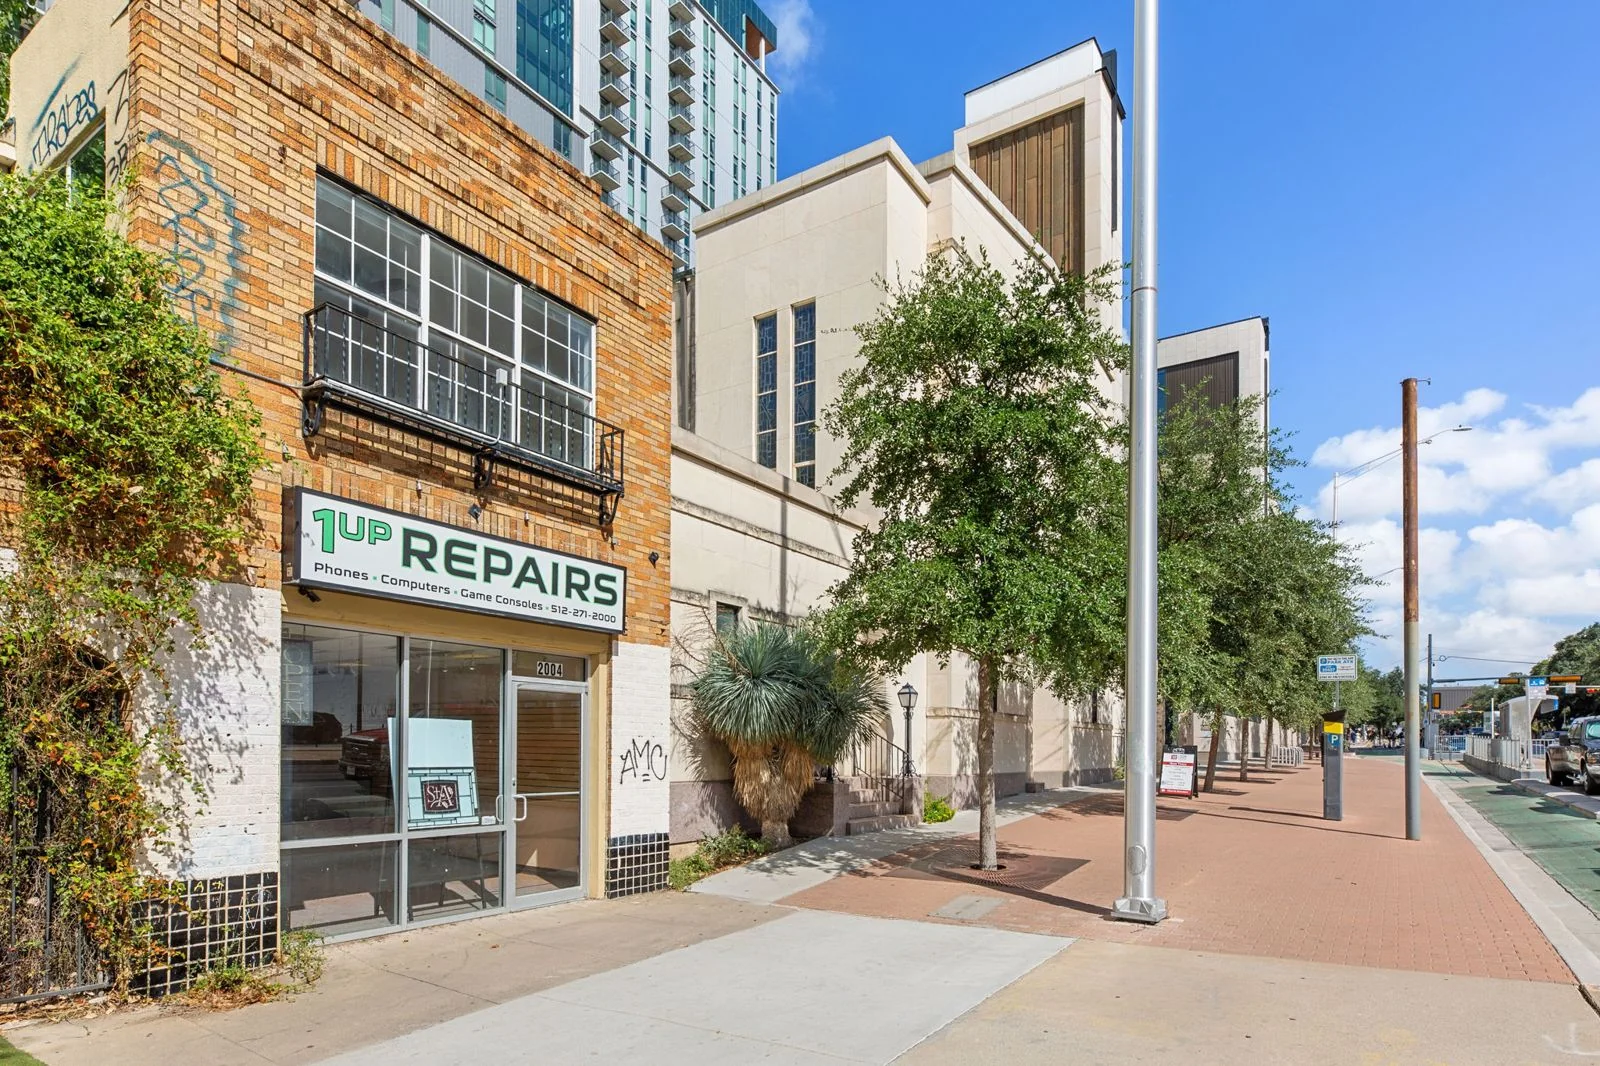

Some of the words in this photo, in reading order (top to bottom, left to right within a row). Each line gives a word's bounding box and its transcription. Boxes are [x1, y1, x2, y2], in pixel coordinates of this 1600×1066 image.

[314, 562, 369, 581] Phones
[381, 574, 450, 594] Computers
[460, 588, 492, 602] Game
[495, 594, 543, 611] Consoles
[551, 605, 616, 624] 512-271-2000
[401, 526, 618, 606] REPAIRS
[537, 662, 562, 677] 2004
[620, 738, 668, 784] AMC
